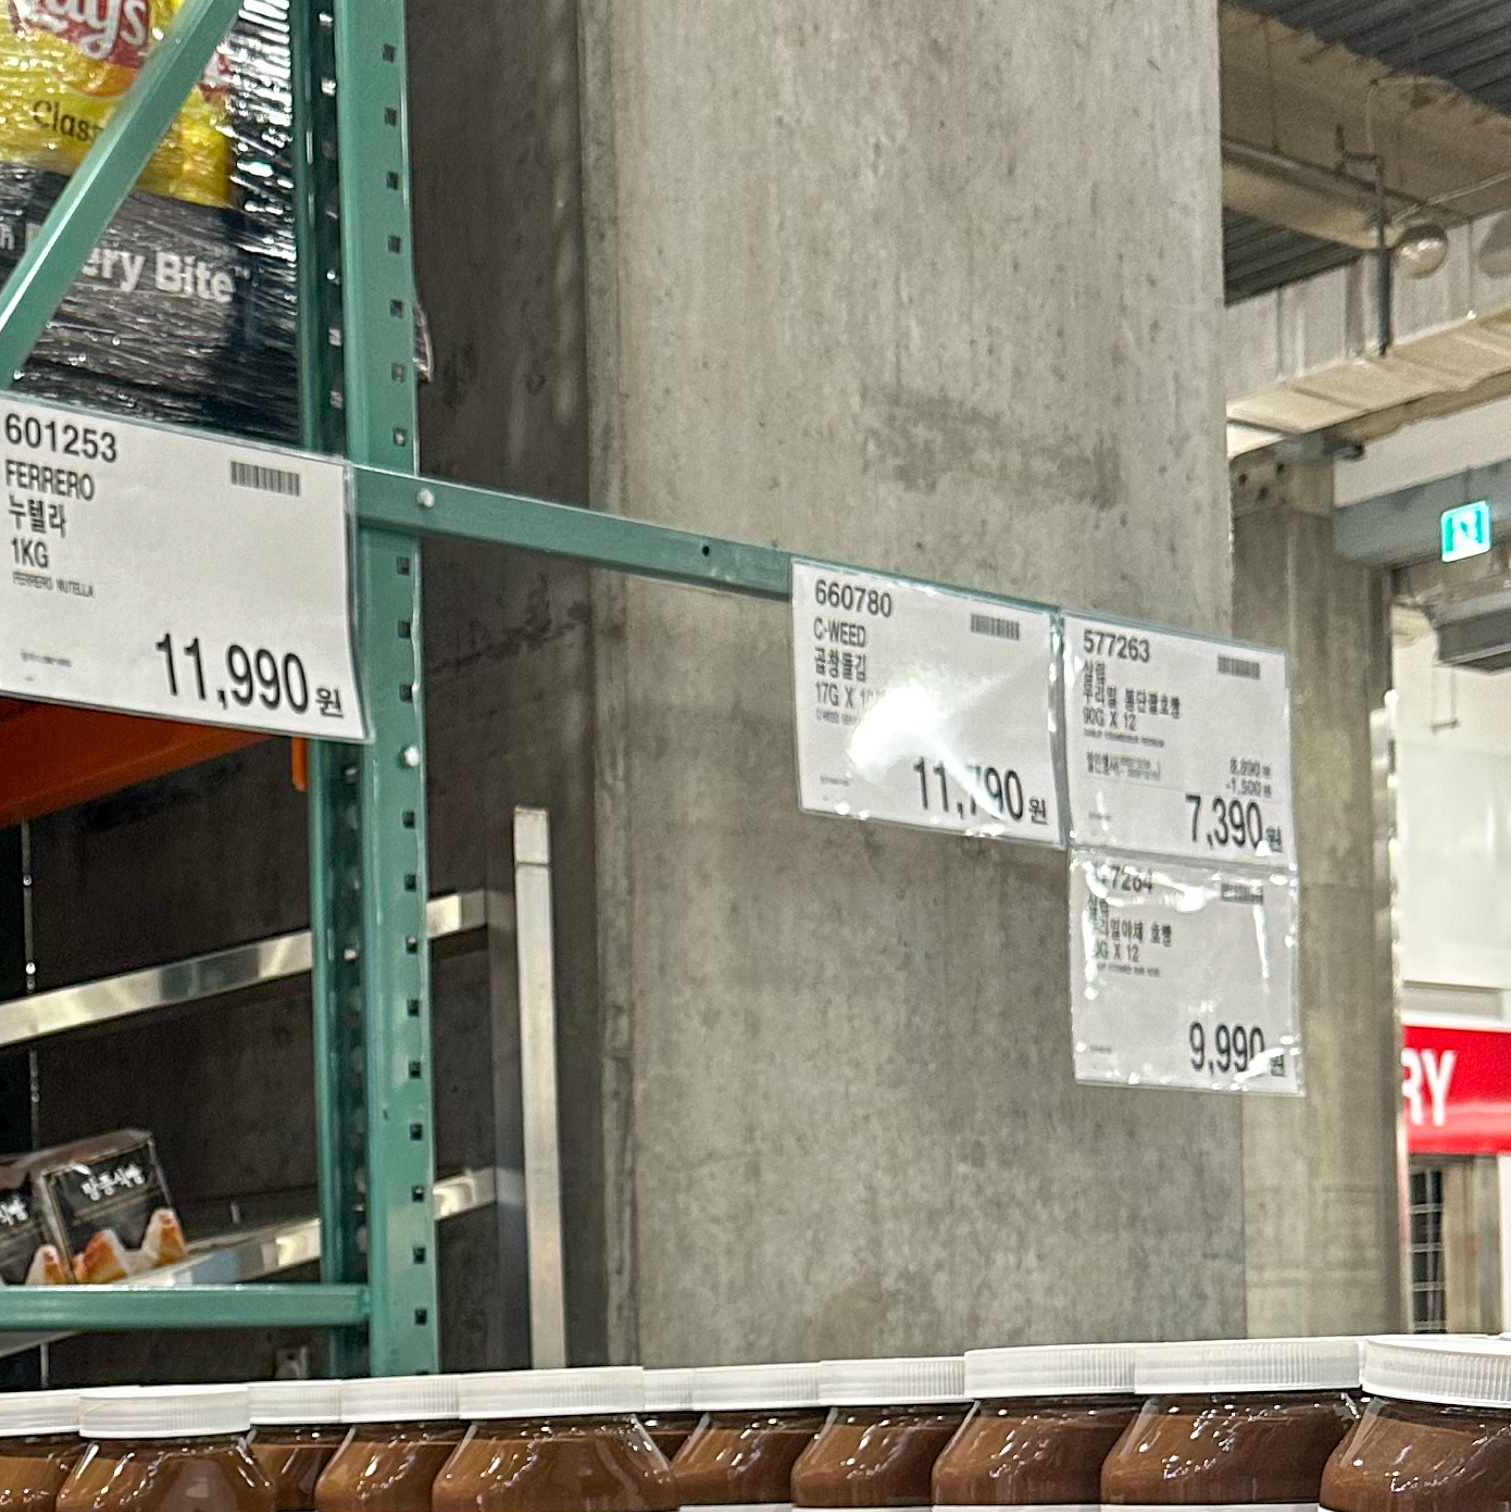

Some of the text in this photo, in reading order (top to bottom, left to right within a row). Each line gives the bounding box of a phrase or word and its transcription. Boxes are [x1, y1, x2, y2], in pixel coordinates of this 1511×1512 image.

[5, 413, 117, 463] 601253
[5, 459, 95, 501] FERRERO
[8, 494, 67, 538] 누텔라
[11, 538, 49, 568] 1KG
[814, 579, 892, 618] 660780
[813, 617, 866, 649] C-WEED
[1083, 629, 1150, 663] 577263
[815, 681, 839, 707] 17G
[844, 685, 854, 710] X
[1124, 713, 1137, 731] 12
[1127, 944, 1140, 963] 12
